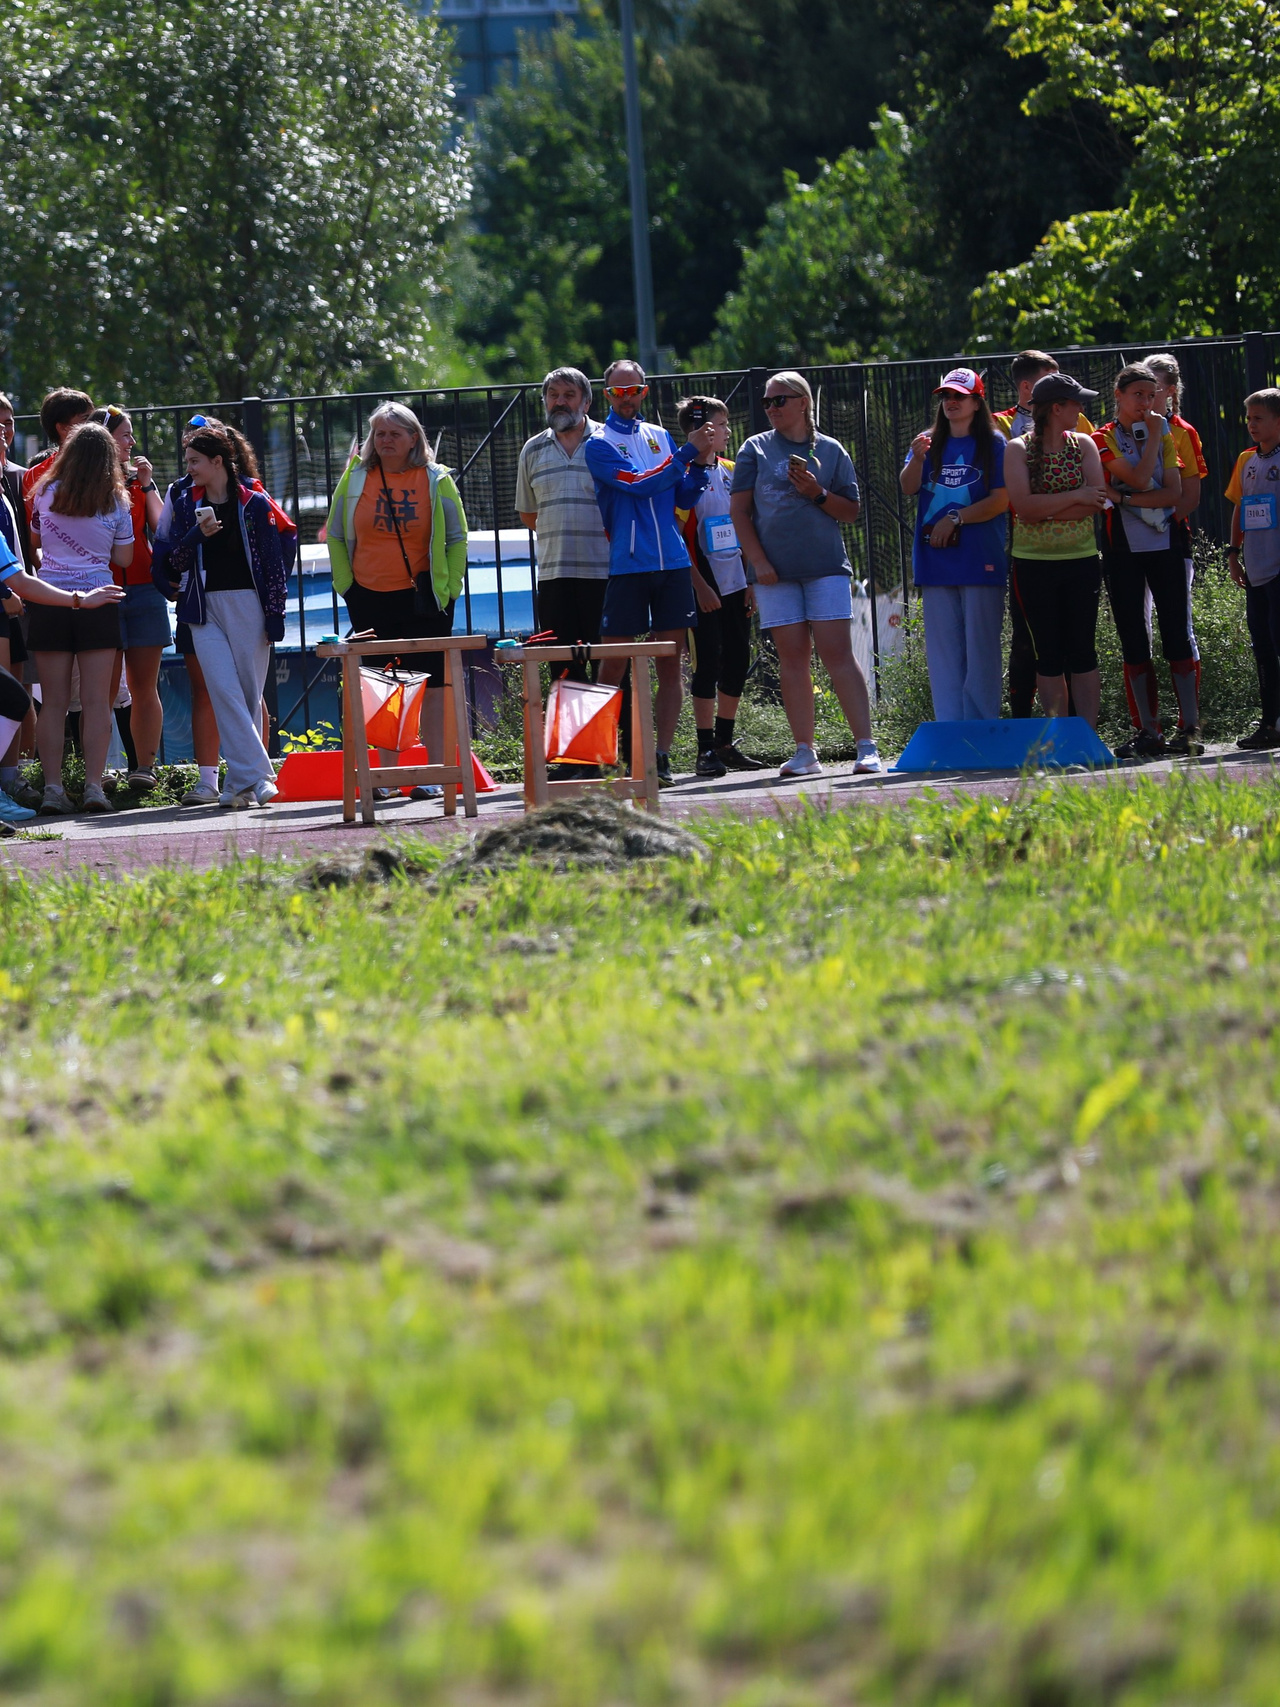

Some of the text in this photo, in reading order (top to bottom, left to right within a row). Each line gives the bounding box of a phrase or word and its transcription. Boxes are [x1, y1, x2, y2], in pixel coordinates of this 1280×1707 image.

[941, 467, 967, 477] SPORTY
[944, 476, 961, 486] BABY
[1248, 509, 1265, 518] 310.2
[43, 518, 90, 557] OFF-SCALES
[716, 529, 732, 539] 310.3
